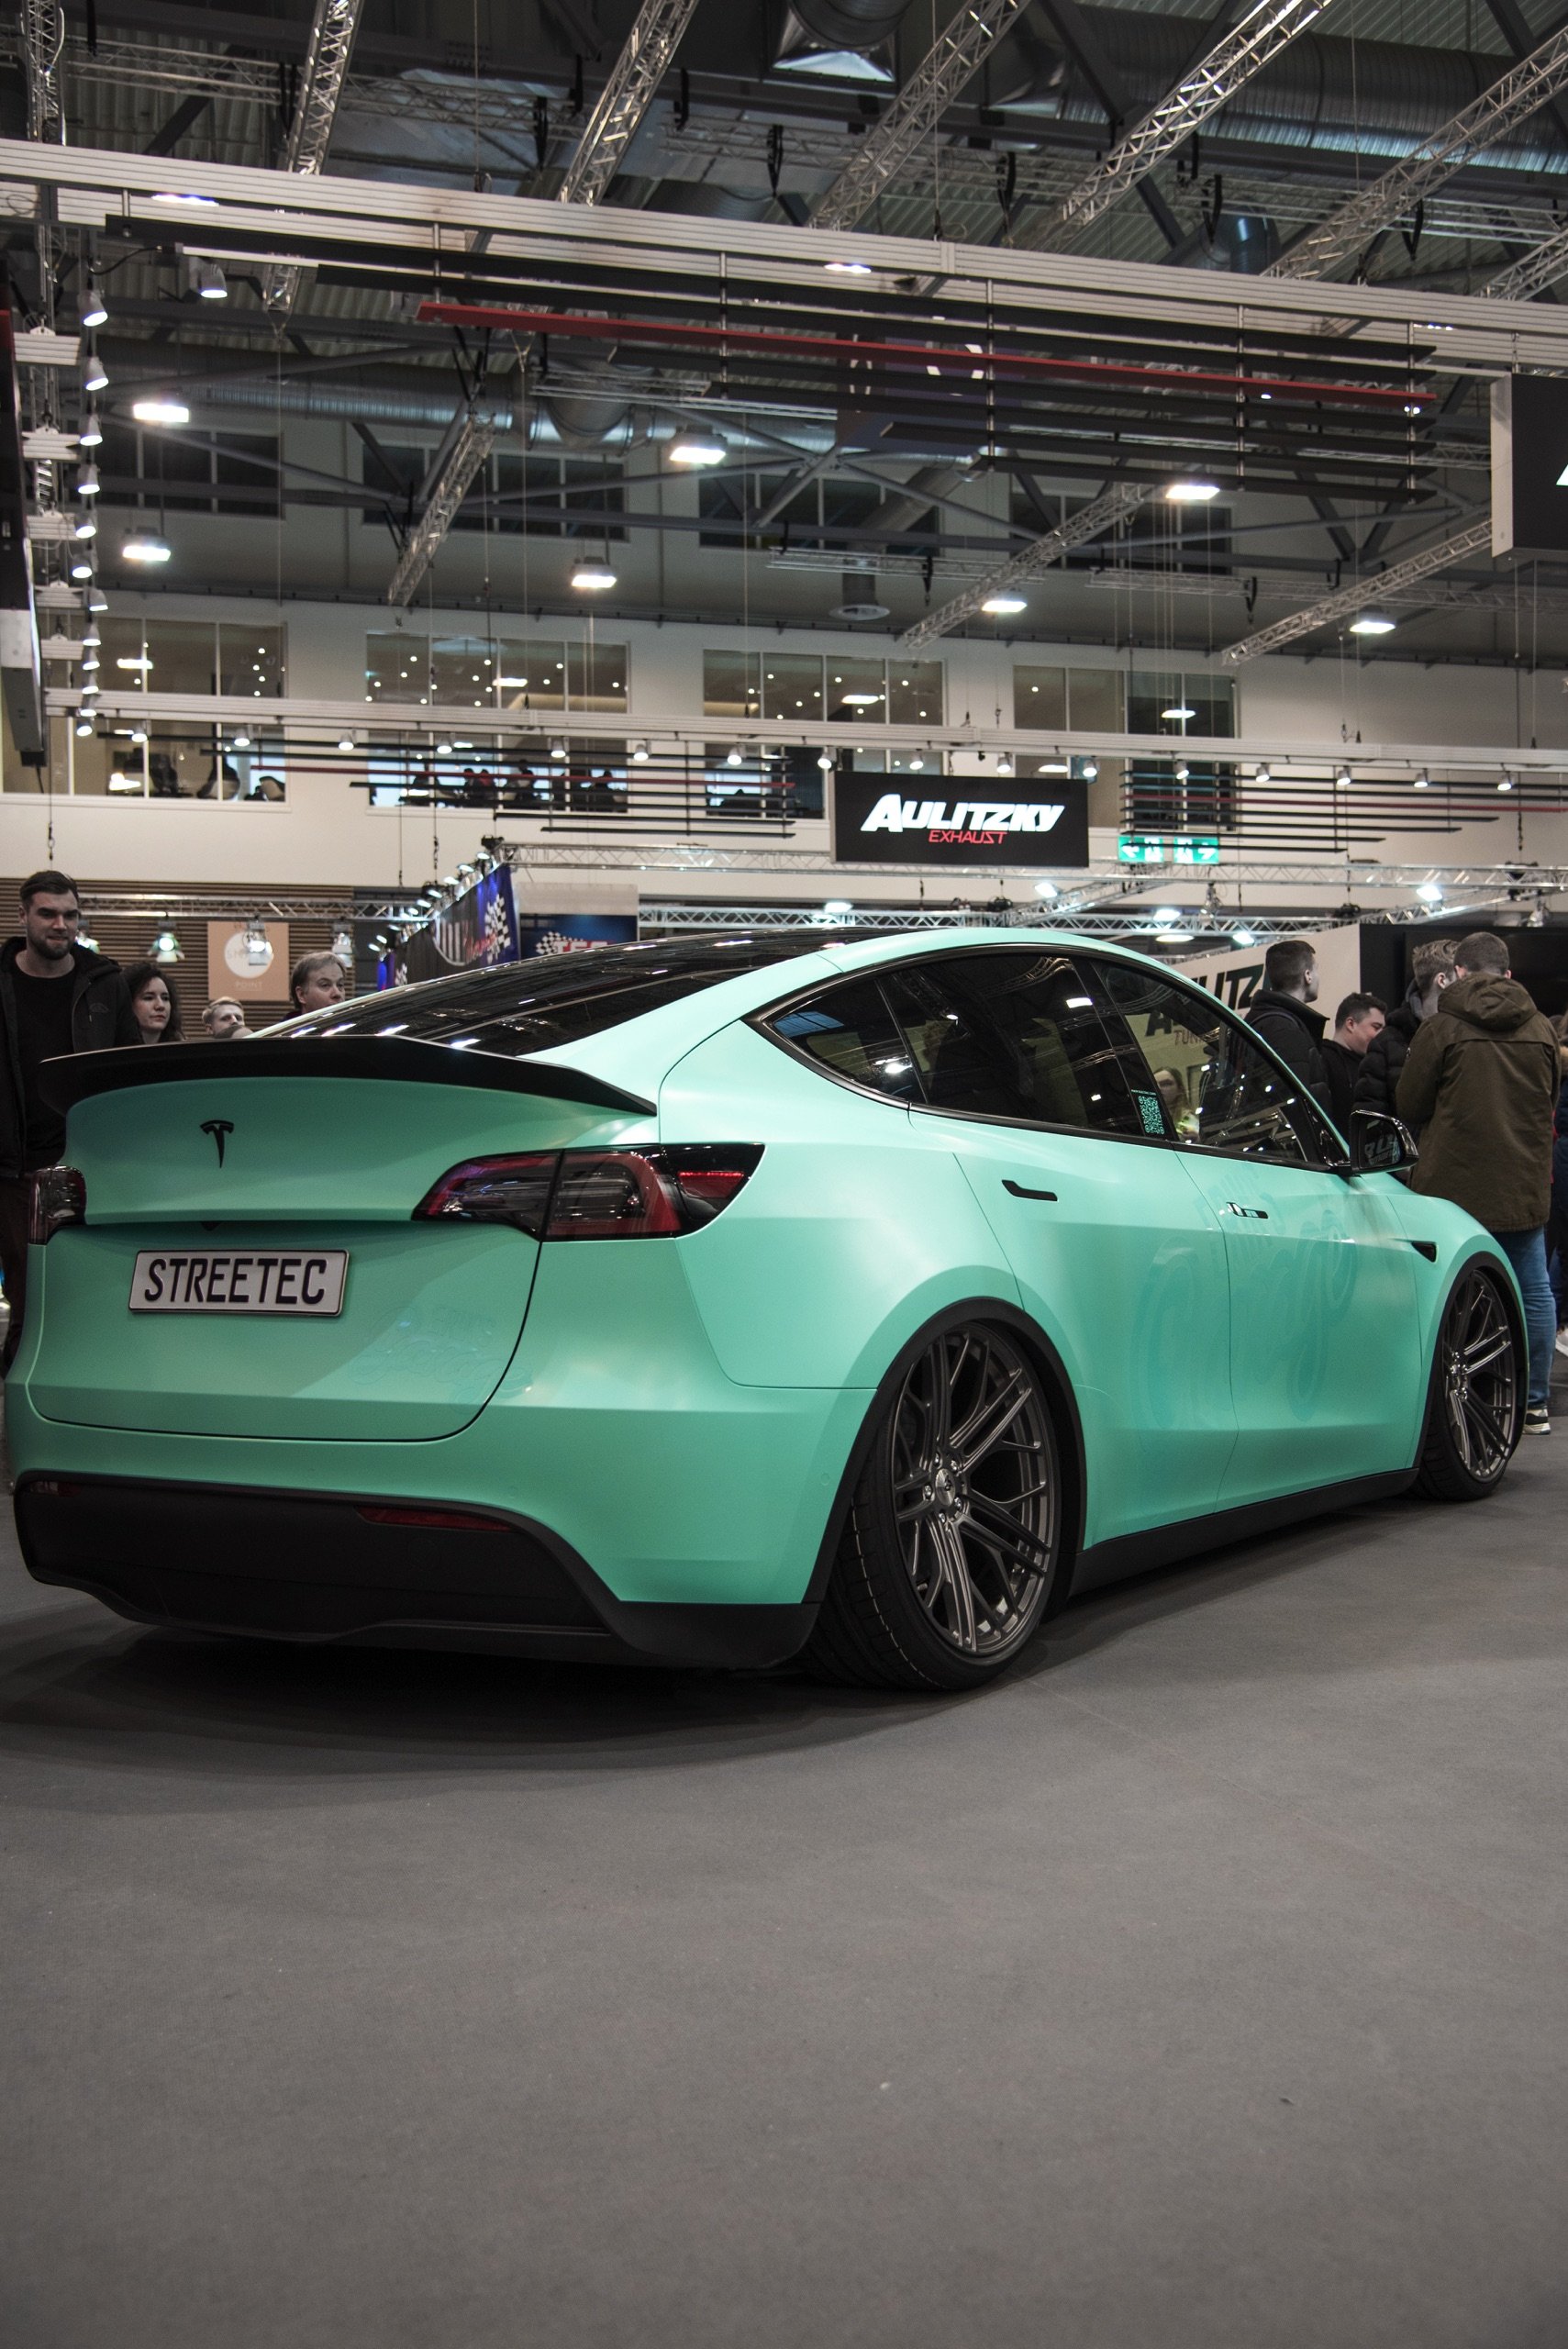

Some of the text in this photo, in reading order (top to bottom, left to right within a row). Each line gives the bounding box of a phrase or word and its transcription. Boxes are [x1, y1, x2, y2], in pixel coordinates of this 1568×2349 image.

[861, 794, 1065, 832] AULITZKY
[929, 829, 1007, 844] EXHAUST
[144, 1258, 328, 1304] STREETEC
